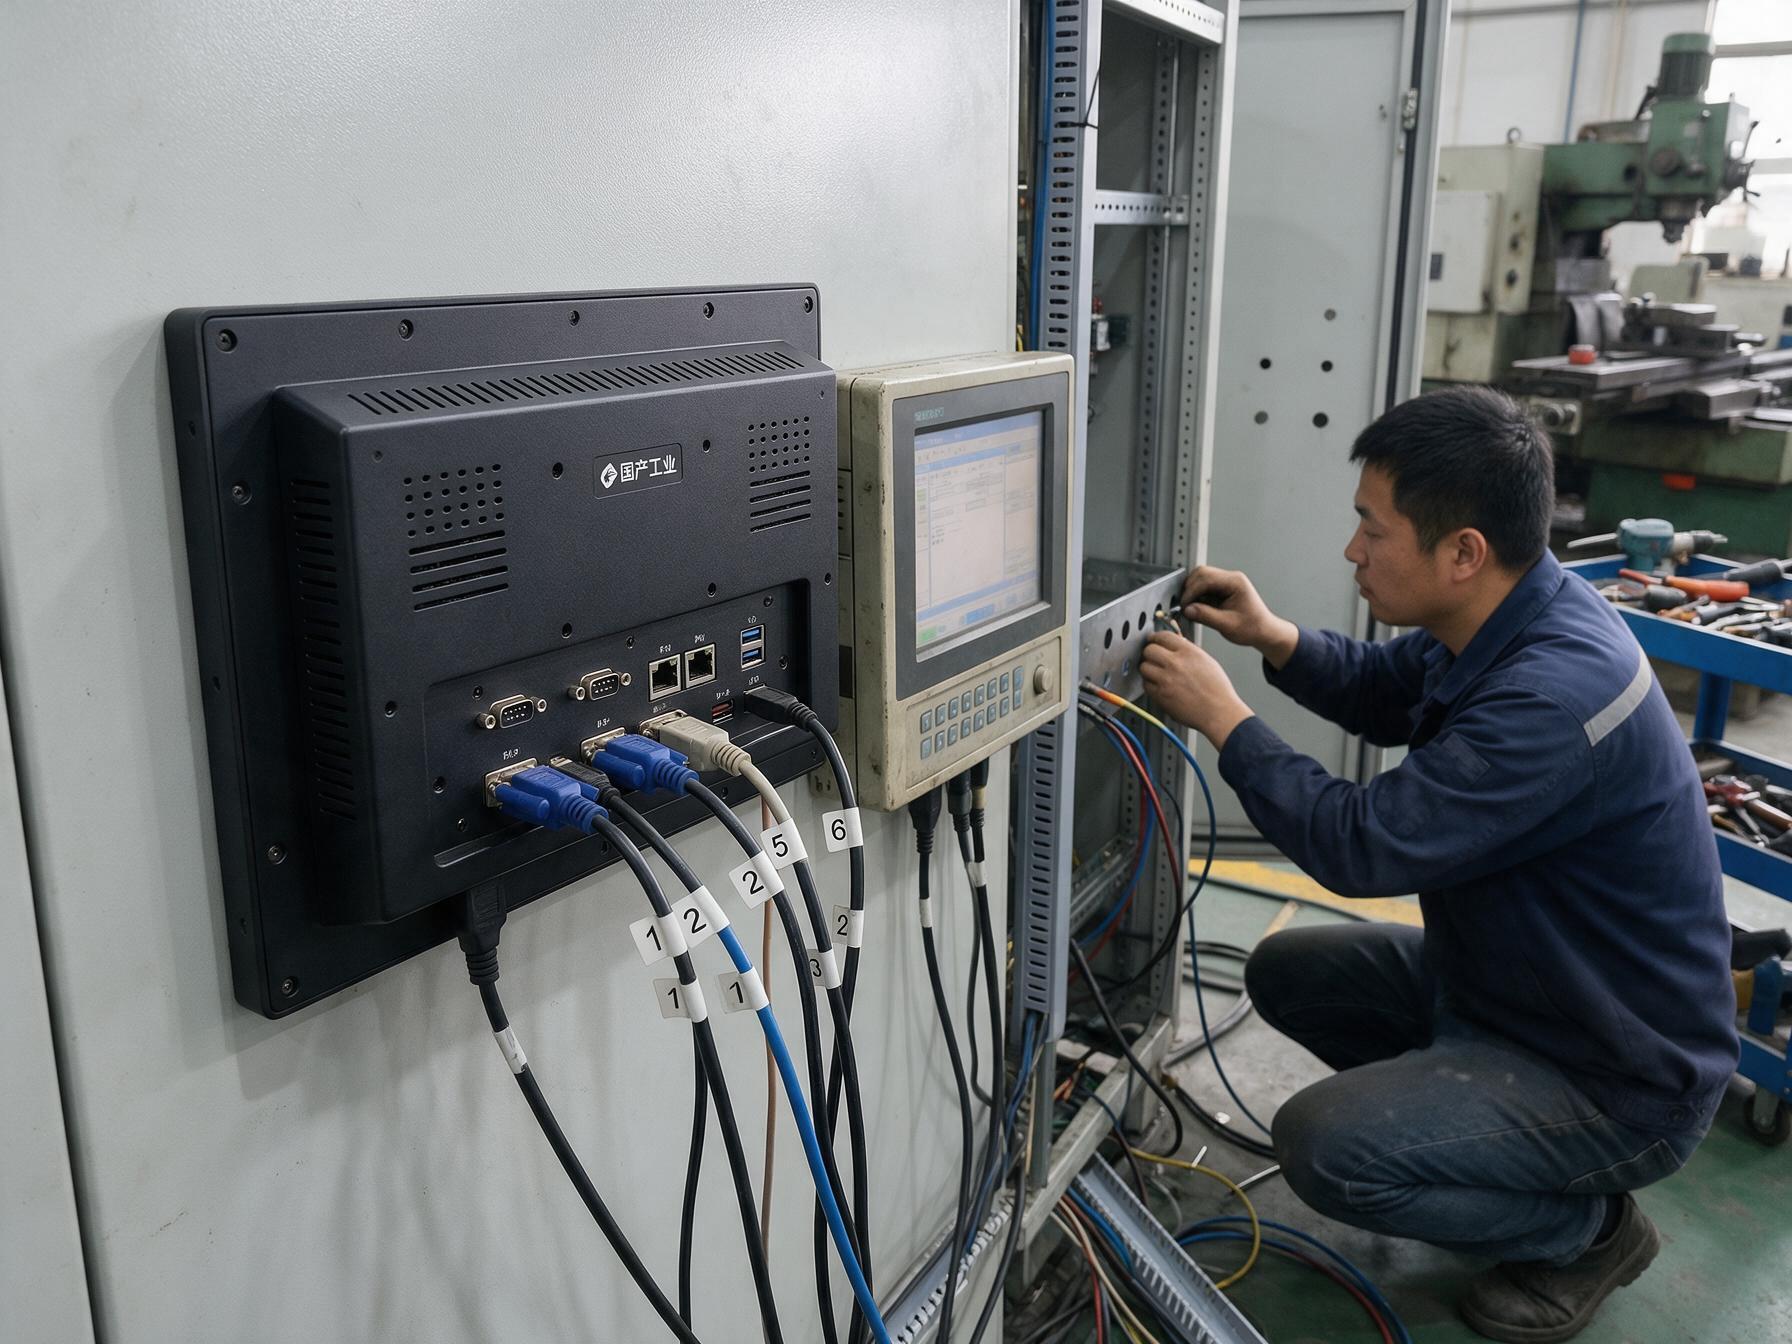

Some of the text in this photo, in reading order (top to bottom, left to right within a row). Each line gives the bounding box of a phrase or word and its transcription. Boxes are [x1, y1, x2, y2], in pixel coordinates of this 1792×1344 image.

[620, 454, 677, 482] 国产工业
[830, 818, 847, 841] 6
[771, 833, 789, 858] 5
[742, 870, 765, 895] 2
[683, 907, 707, 934] 2
[836, 914, 849, 937] 2
[646, 925, 662, 952] 1
[809, 958, 822, 978] 3
[667, 987, 680, 1010] 1
[729, 981, 744, 1004] 1
